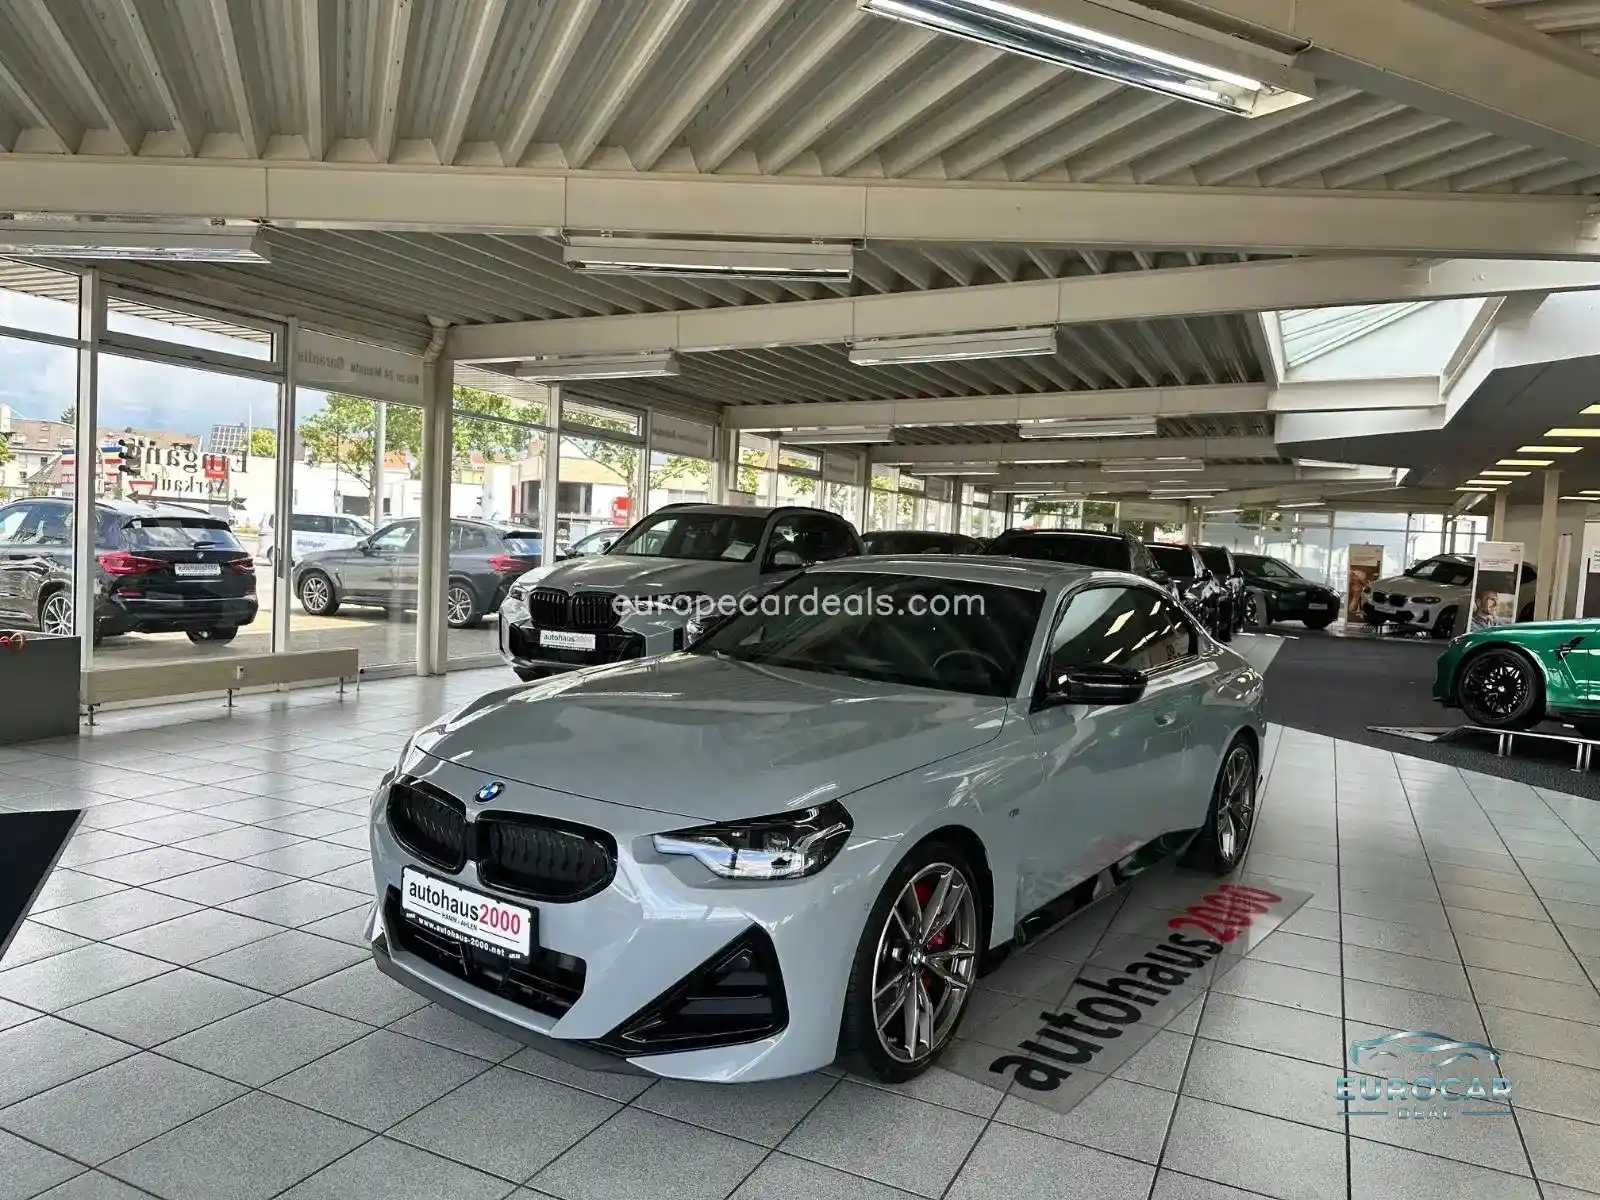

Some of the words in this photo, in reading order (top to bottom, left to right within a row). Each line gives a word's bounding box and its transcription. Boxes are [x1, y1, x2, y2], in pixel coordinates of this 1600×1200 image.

[409, 881, 521, 935] autohaus2000
[418, 917, 505, 956] www.autohaus-2000.net
[989, 884, 1283, 1092] autohaus2000
